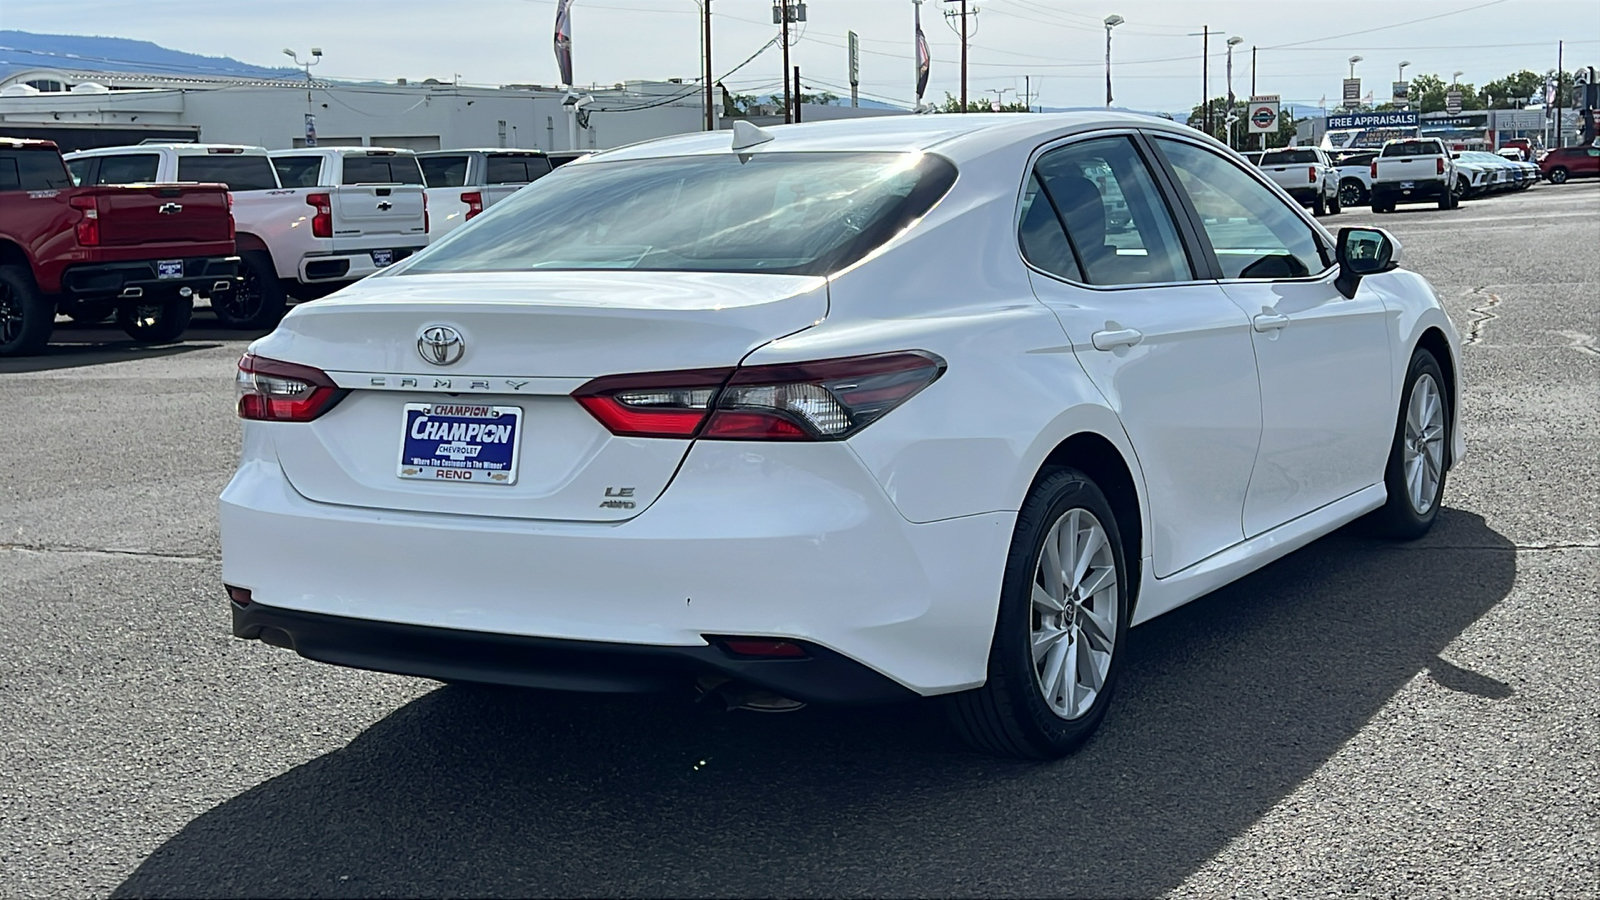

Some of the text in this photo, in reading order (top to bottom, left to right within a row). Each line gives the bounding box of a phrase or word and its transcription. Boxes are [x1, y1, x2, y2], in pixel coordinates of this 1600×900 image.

[1329, 114, 1416, 127] FREE APPRAISALS!
[1503, 120, 1532, 128] United
[370, 377, 529, 390] CAMRY
[434, 405, 489, 416] CHAMPION
[411, 416, 512, 444] CHAMPION
[438, 446, 478, 455] CHEVROLET
[431, 458, 441, 466] The
[441, 459, 466, 468] Customer
[473, 461, 483, 469] The
[436, 469, 472, 480] RENO
[605, 487, 635, 497] LE
[599, 500, 636, 509] AWD
